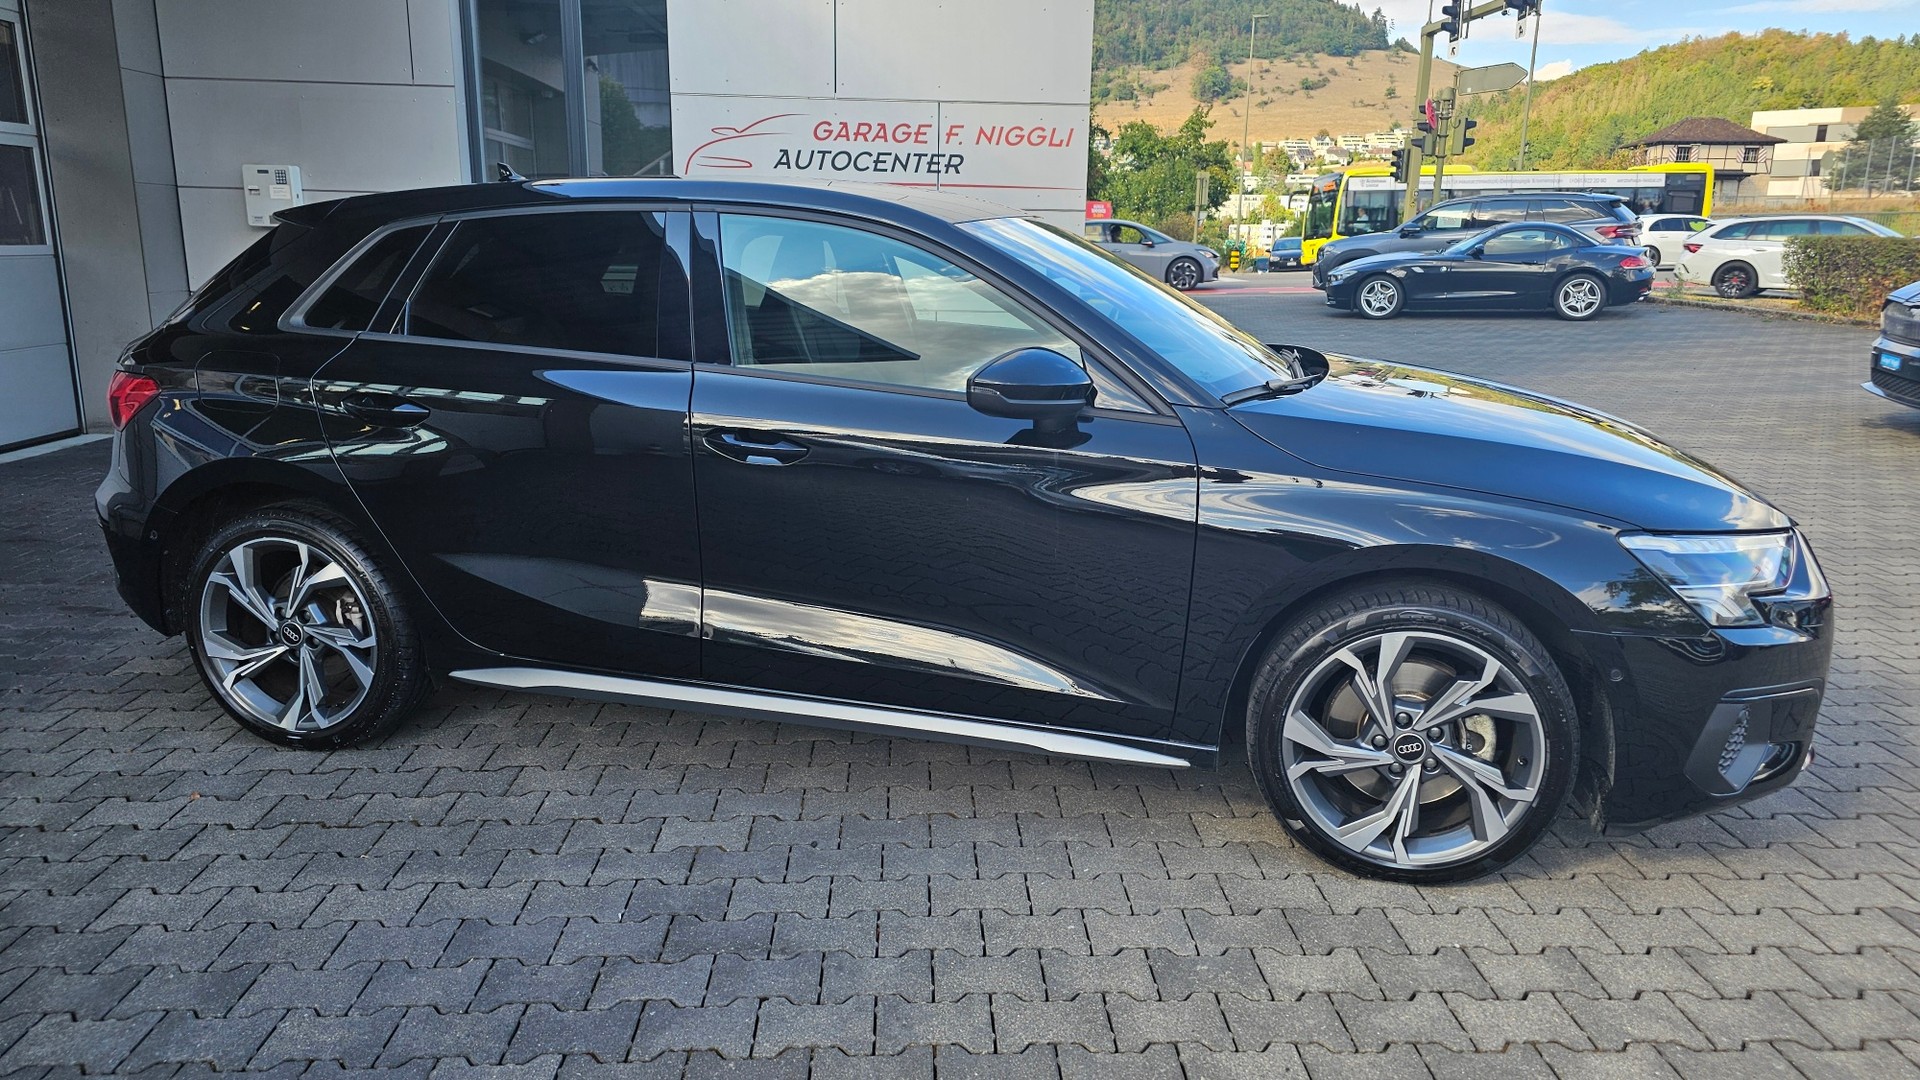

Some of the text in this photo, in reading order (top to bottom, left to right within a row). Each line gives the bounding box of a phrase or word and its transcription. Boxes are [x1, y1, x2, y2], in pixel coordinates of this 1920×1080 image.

[813, 120, 1074, 148] GARAGE F. NIGGLI
[773, 149, 965, 175] AUTOCENTER
